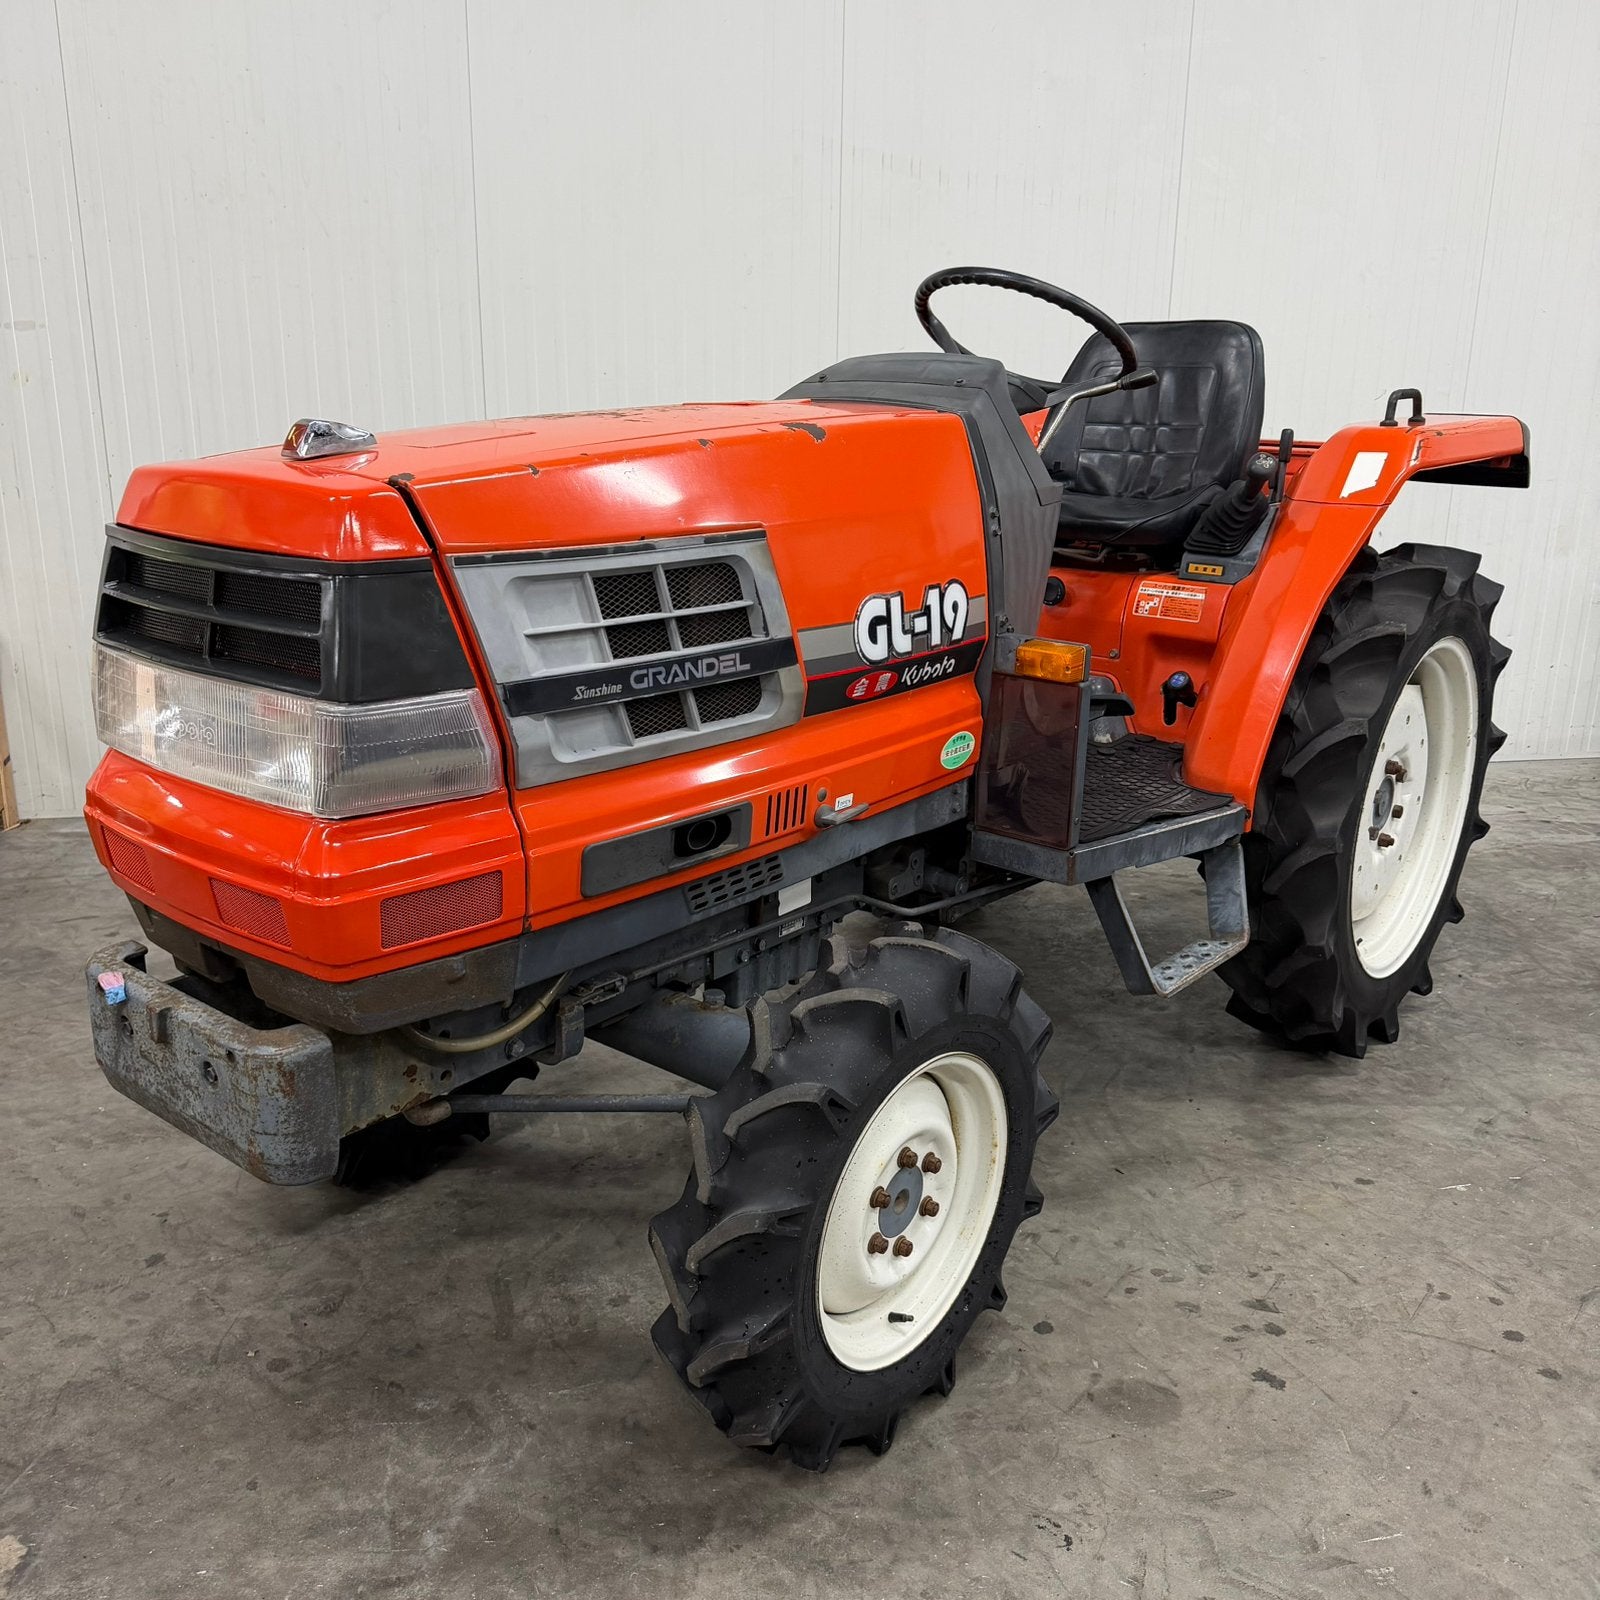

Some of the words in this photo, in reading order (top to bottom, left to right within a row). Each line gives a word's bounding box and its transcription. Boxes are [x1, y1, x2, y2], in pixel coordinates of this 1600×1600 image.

[855, 580, 968, 664] GL-19
[572, 683, 623, 700] Sunshine
[630, 653, 750, 689] GRANDEL
[901, 656, 956, 686] Kubota
